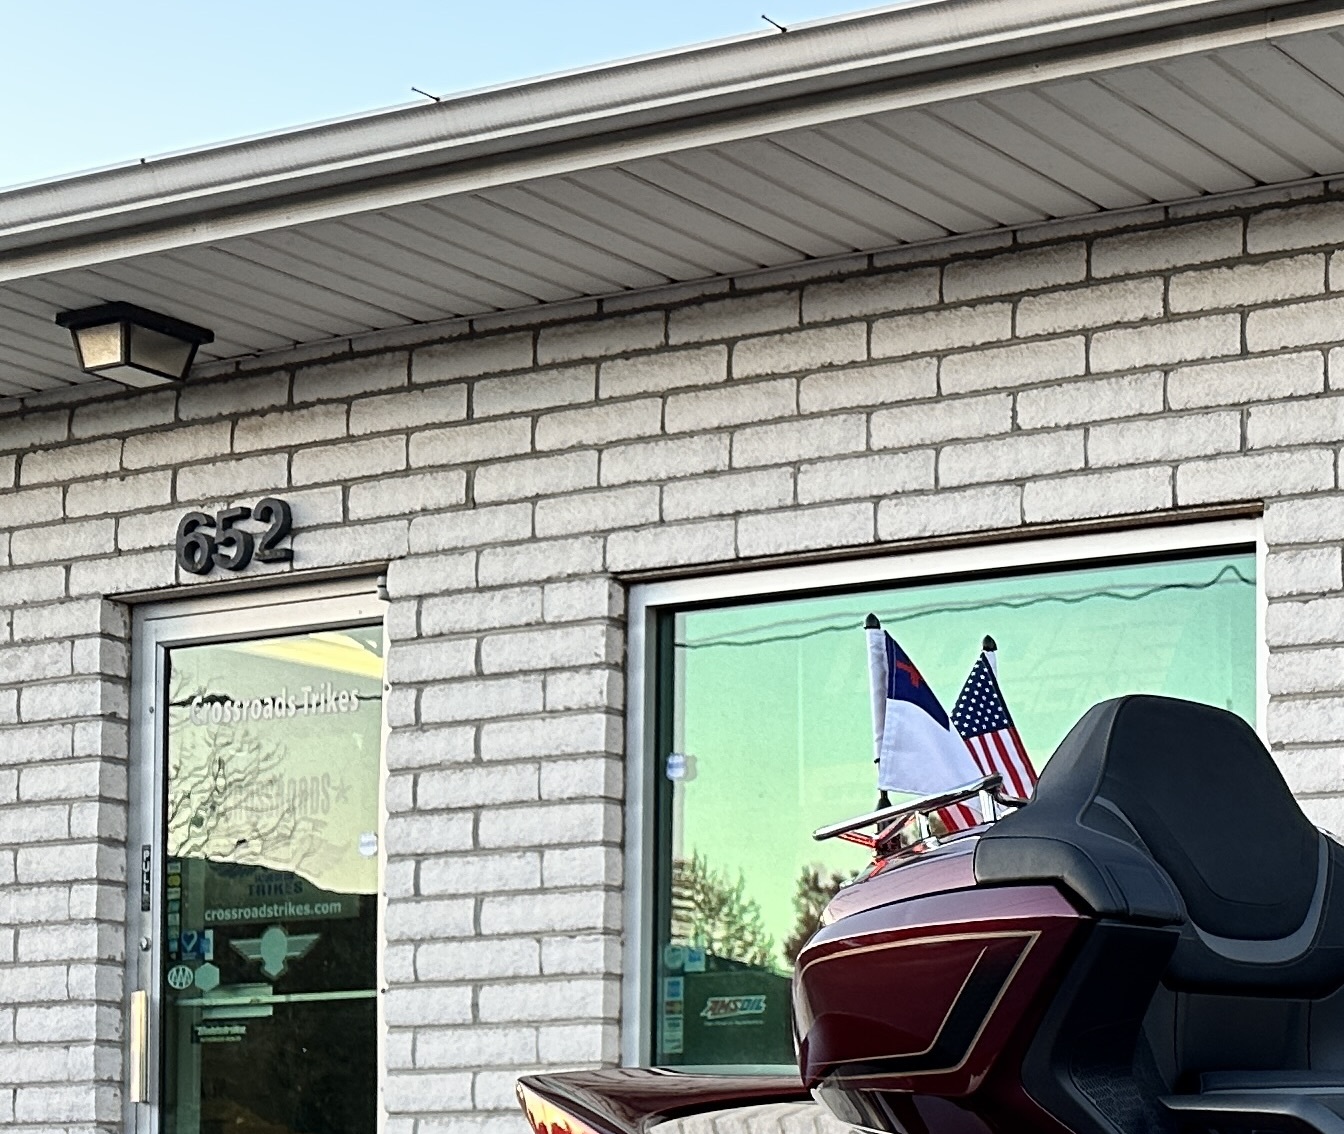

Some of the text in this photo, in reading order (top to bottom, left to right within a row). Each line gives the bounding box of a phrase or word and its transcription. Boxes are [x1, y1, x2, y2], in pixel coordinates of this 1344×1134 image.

[176, 497, 294, 575] 652
[190, 681, 360, 726] Crossroads Trikes
[142, 849, 150, 895] PULL
[204, 901, 342, 922] crossroadstrikes.com
